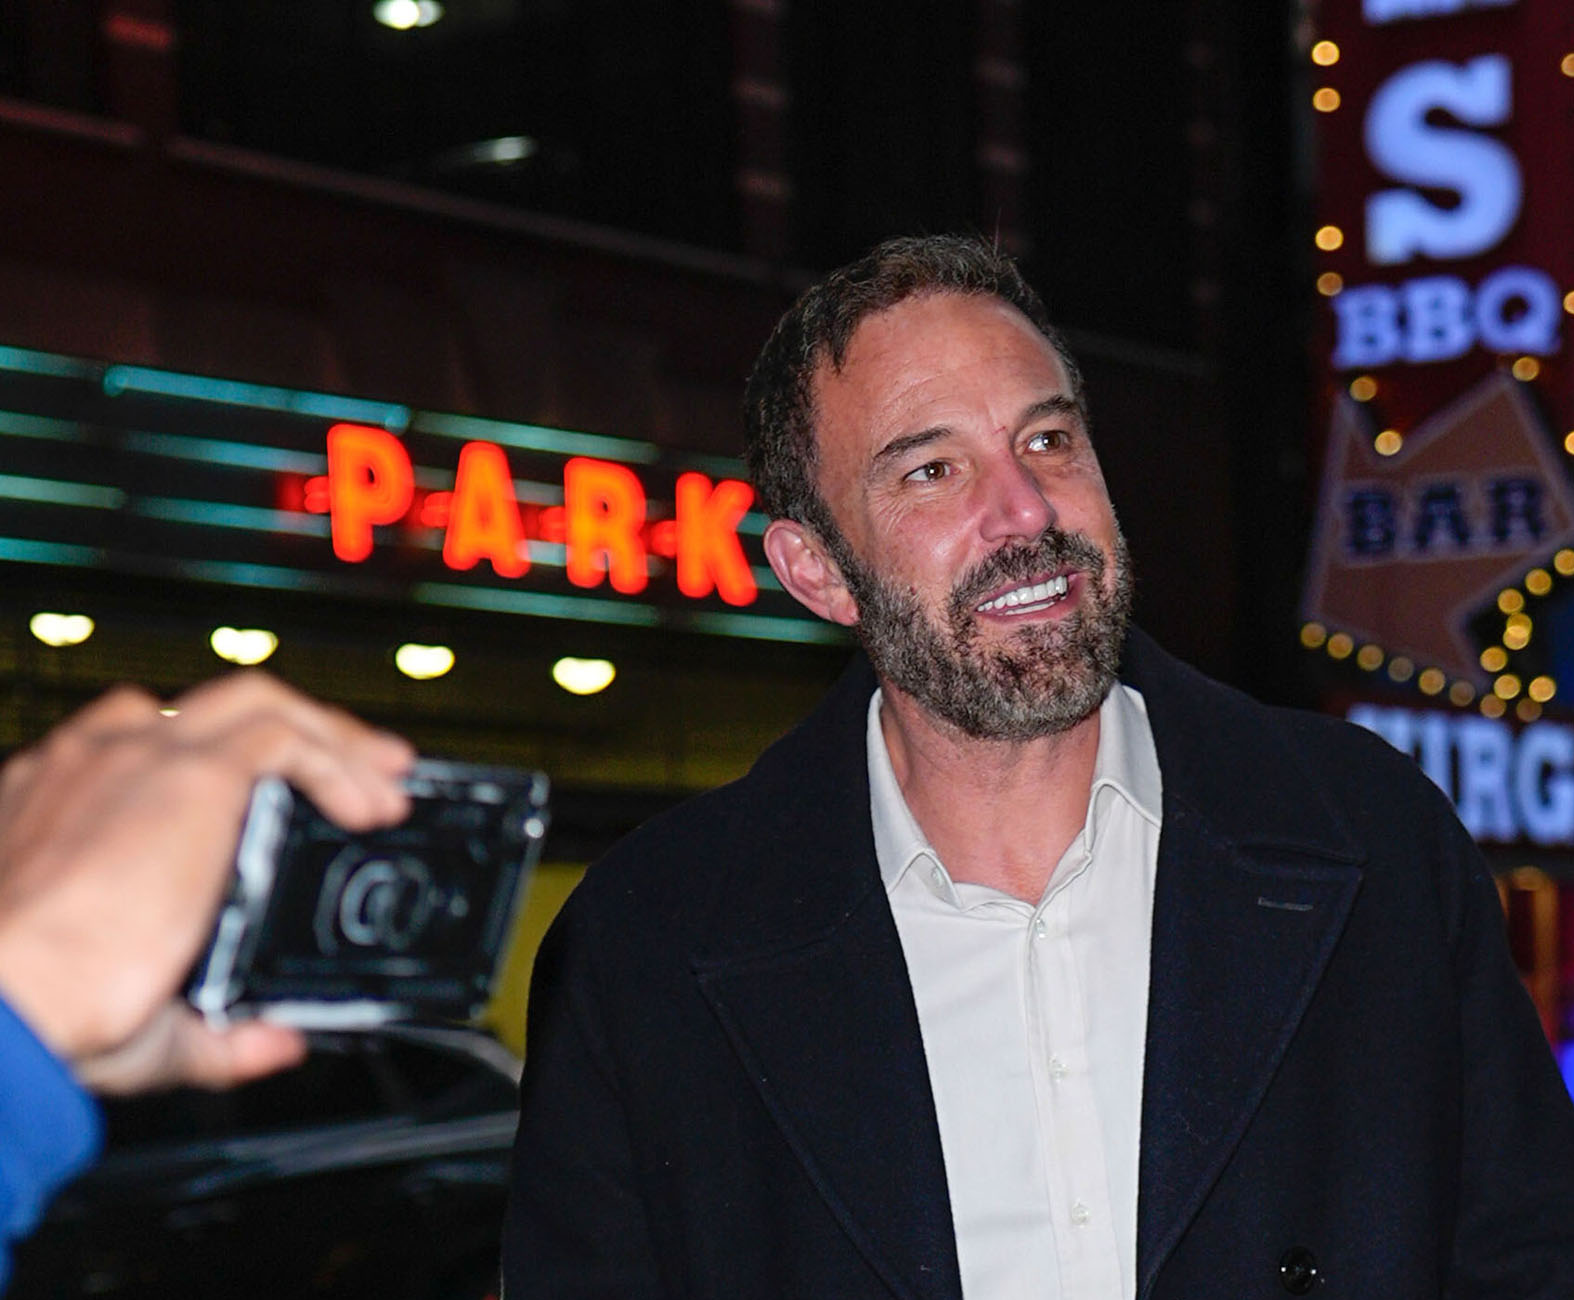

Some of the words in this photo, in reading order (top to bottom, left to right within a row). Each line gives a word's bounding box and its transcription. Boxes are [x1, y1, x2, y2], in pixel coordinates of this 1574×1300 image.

[1362, 0, 1521, 265] S
[1332, 265, 1561, 370] BBQ
[326, 423, 758, 607] PARK
[1346, 477, 1547, 557] BAR
